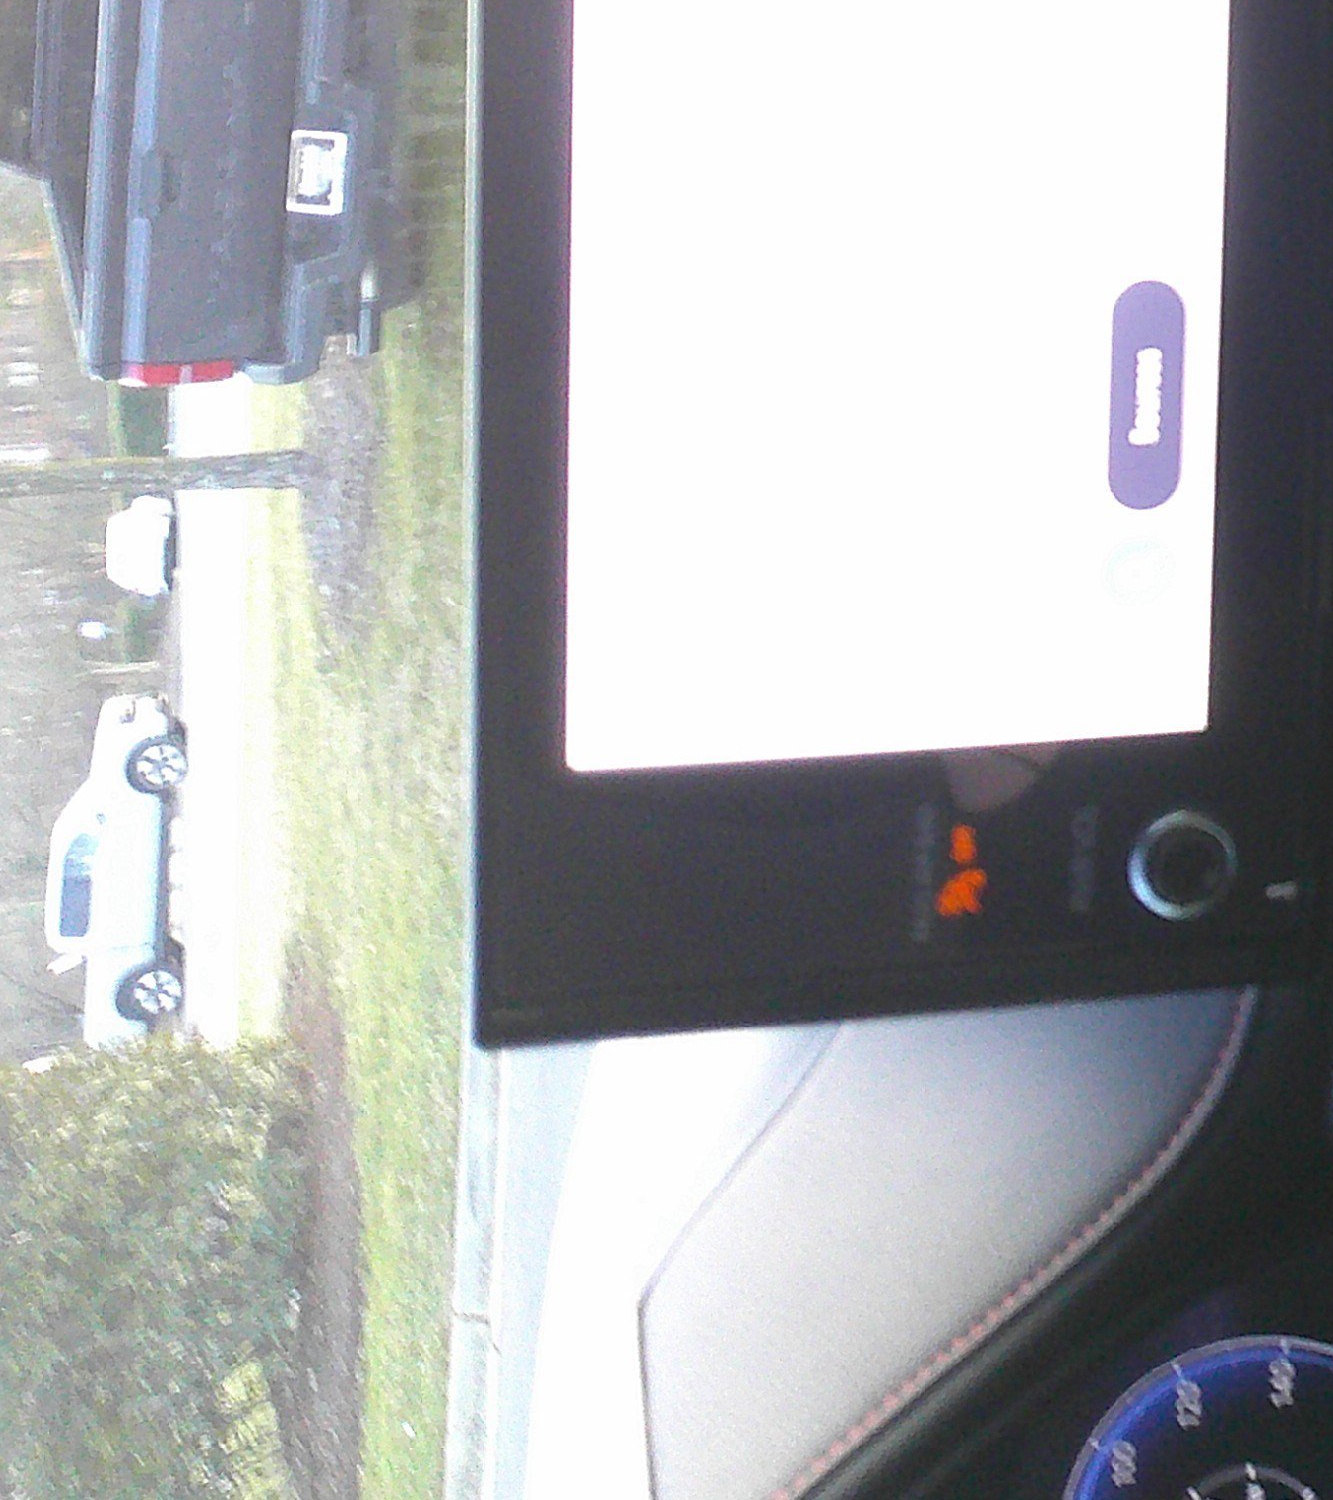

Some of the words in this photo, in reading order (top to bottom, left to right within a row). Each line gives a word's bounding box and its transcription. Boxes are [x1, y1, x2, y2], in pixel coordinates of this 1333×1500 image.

[1175, 1379, 1202, 1430] 120
[1268, 1358, 1296, 1408] 140
[1111, 1440, 1137, 1487] 100
